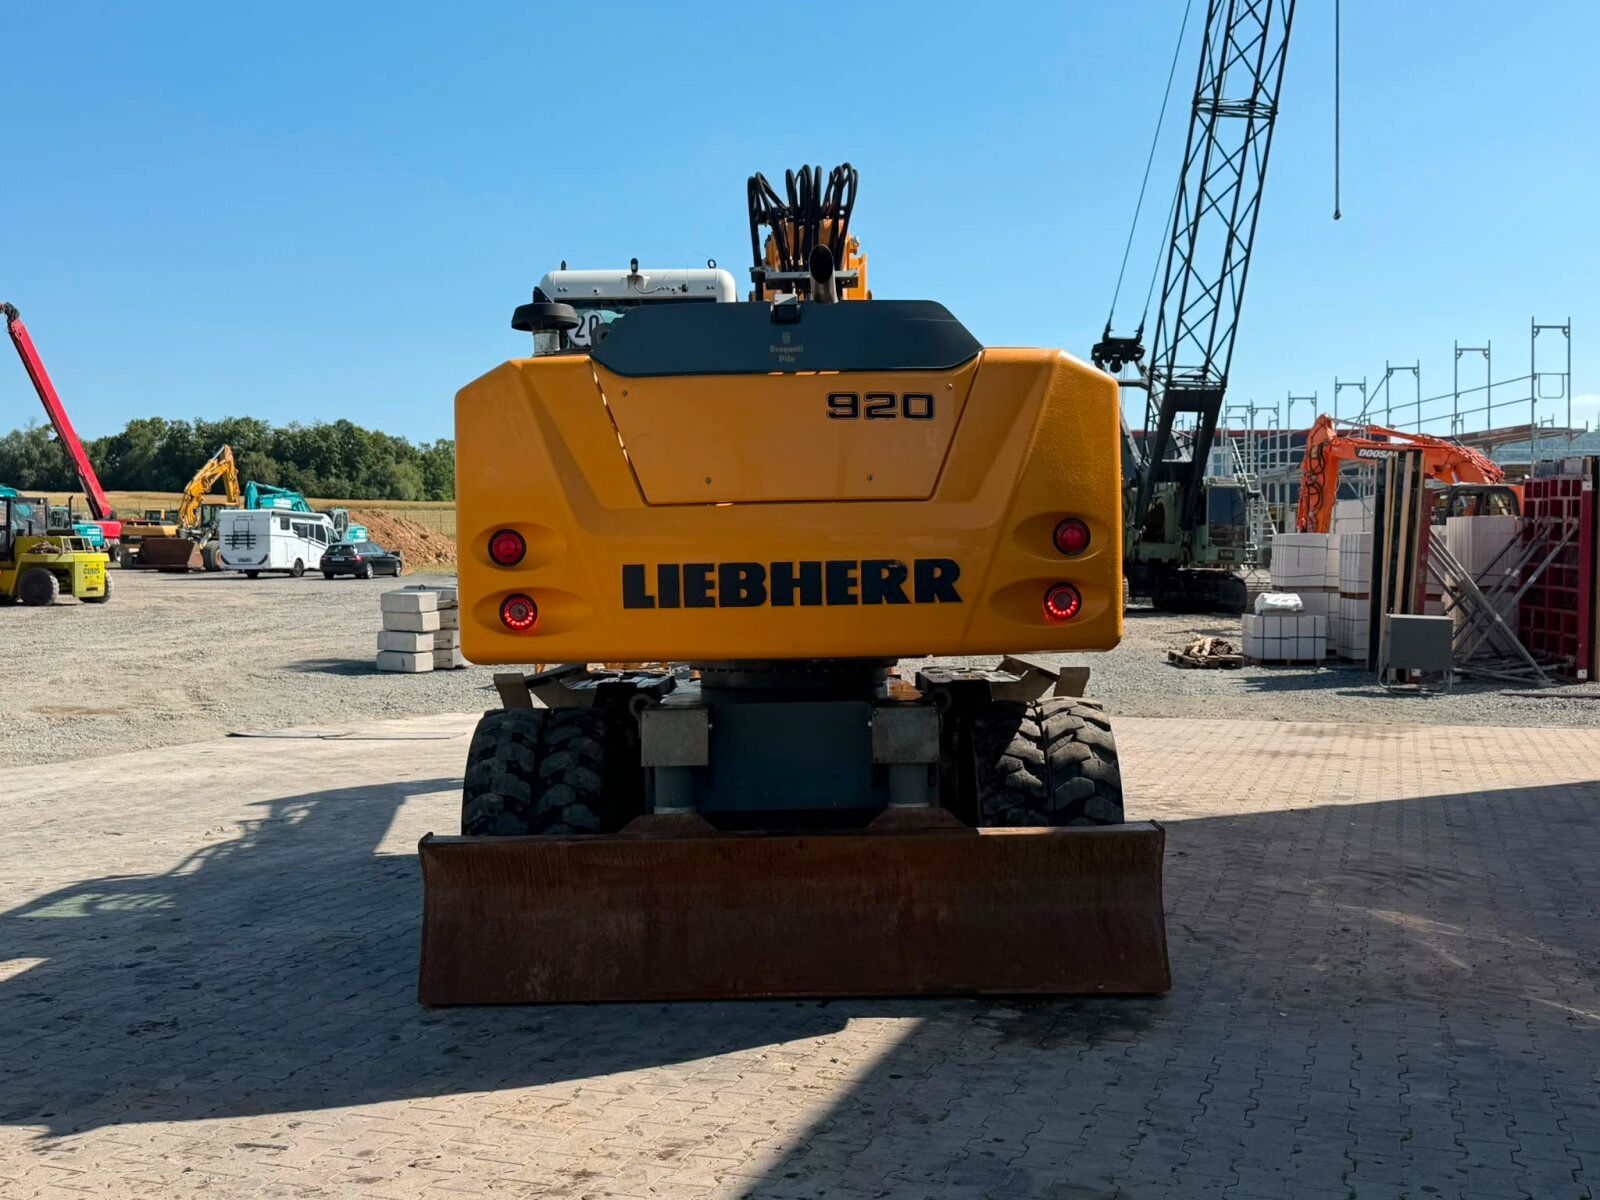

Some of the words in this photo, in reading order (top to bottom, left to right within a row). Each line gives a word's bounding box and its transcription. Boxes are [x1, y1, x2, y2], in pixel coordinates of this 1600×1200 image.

[575, 315, 600, 338] 20
[826, 391, 935, 421] 920
[622, 559, 964, 609] LIEBHERR
